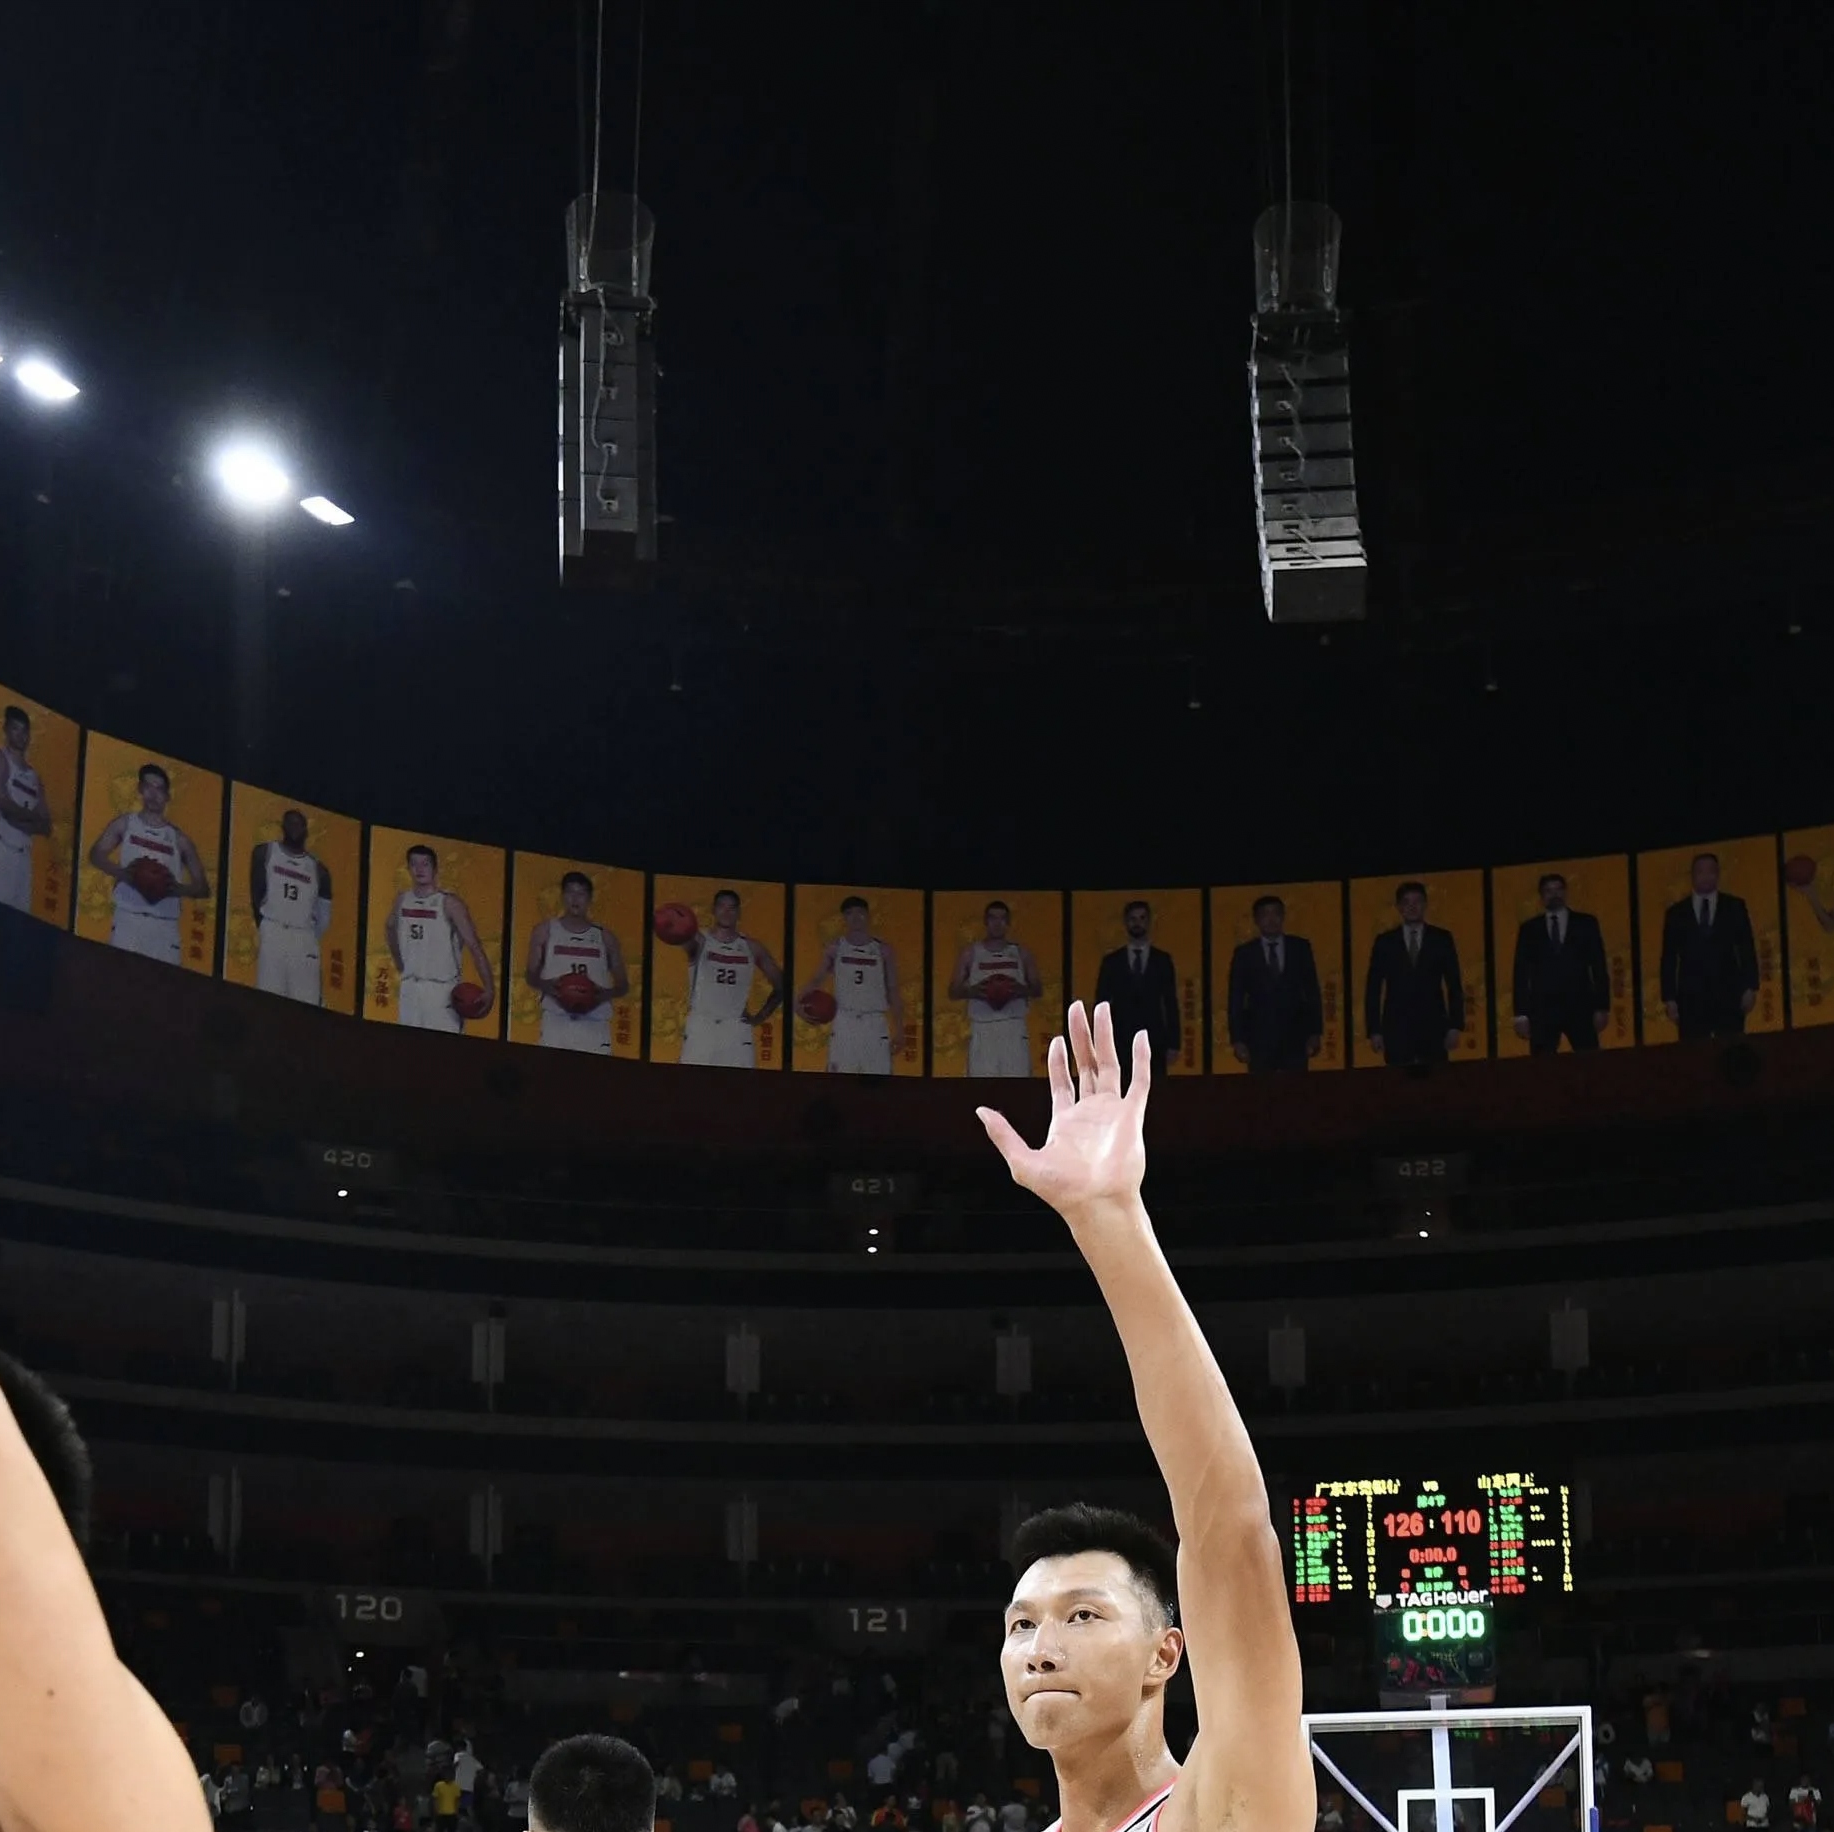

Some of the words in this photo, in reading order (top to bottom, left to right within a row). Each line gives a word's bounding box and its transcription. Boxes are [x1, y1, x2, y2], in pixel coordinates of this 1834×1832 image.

[283, 883, 298, 900] 13
[716, 968, 736, 985] 22
[853, 970, 864, 985] 3
[323, 1149, 372, 1168] 420
[1399, 1159, 1446, 1177] 422
[851, 1177, 896, 1194] 421
[1383, 1512, 1424, 1538] 126
[1441, 1509, 1481, 1535] 110
[335, 1595, 403, 1622] 120
[849, 1607, 908, 1632] 121
